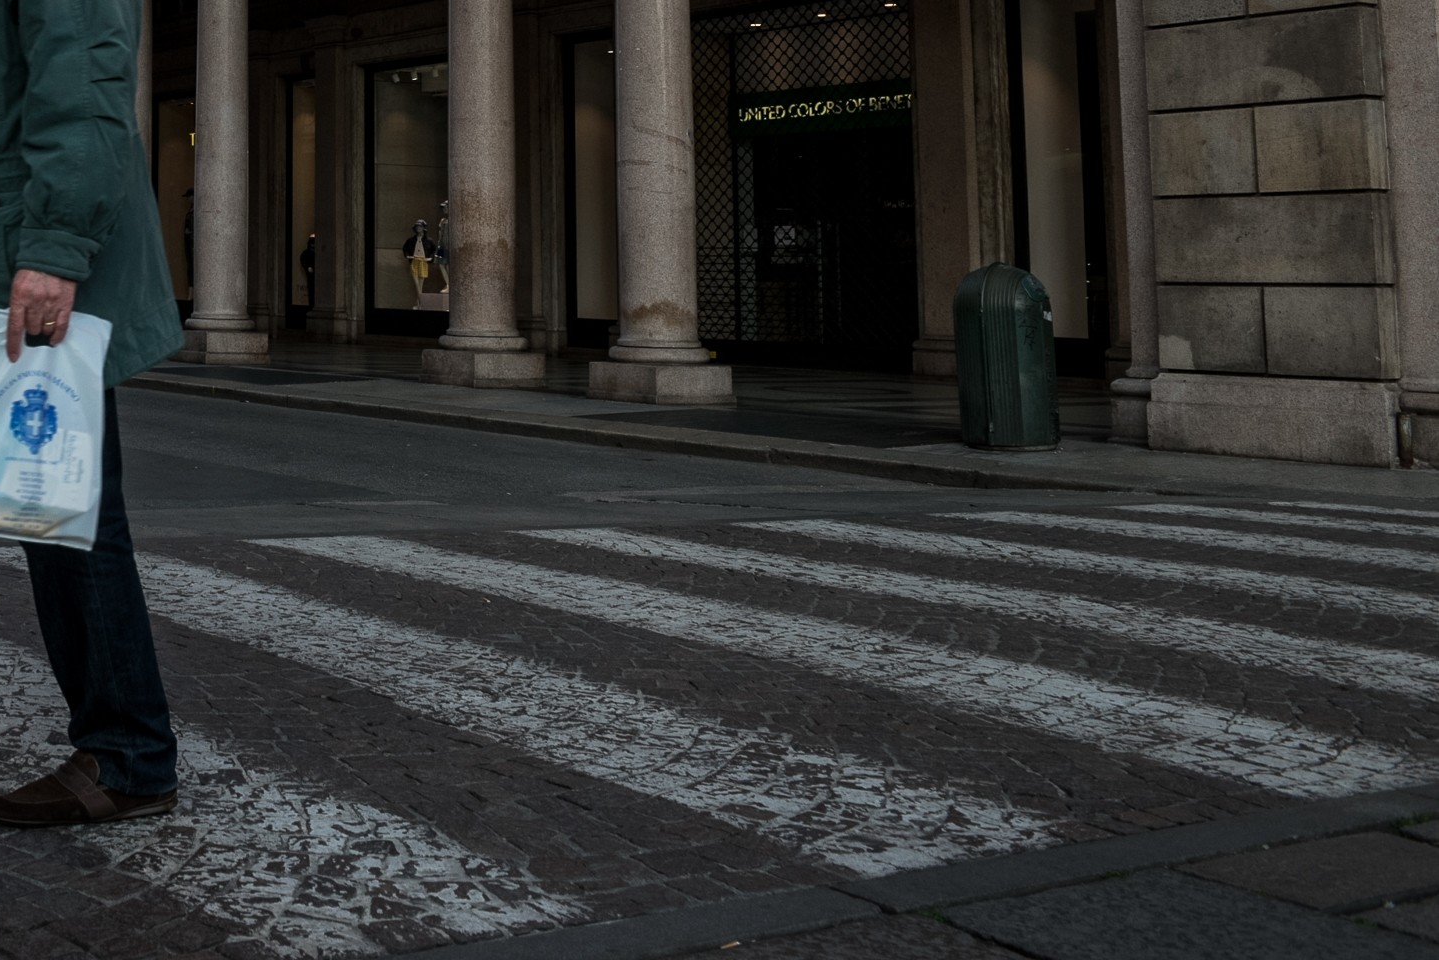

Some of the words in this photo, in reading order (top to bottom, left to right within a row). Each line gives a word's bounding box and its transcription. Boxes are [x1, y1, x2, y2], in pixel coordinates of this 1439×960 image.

[738, 104, 786, 122] UNITED
[788, 100, 843, 119] COLORS
[846, 97, 865, 114] OF
